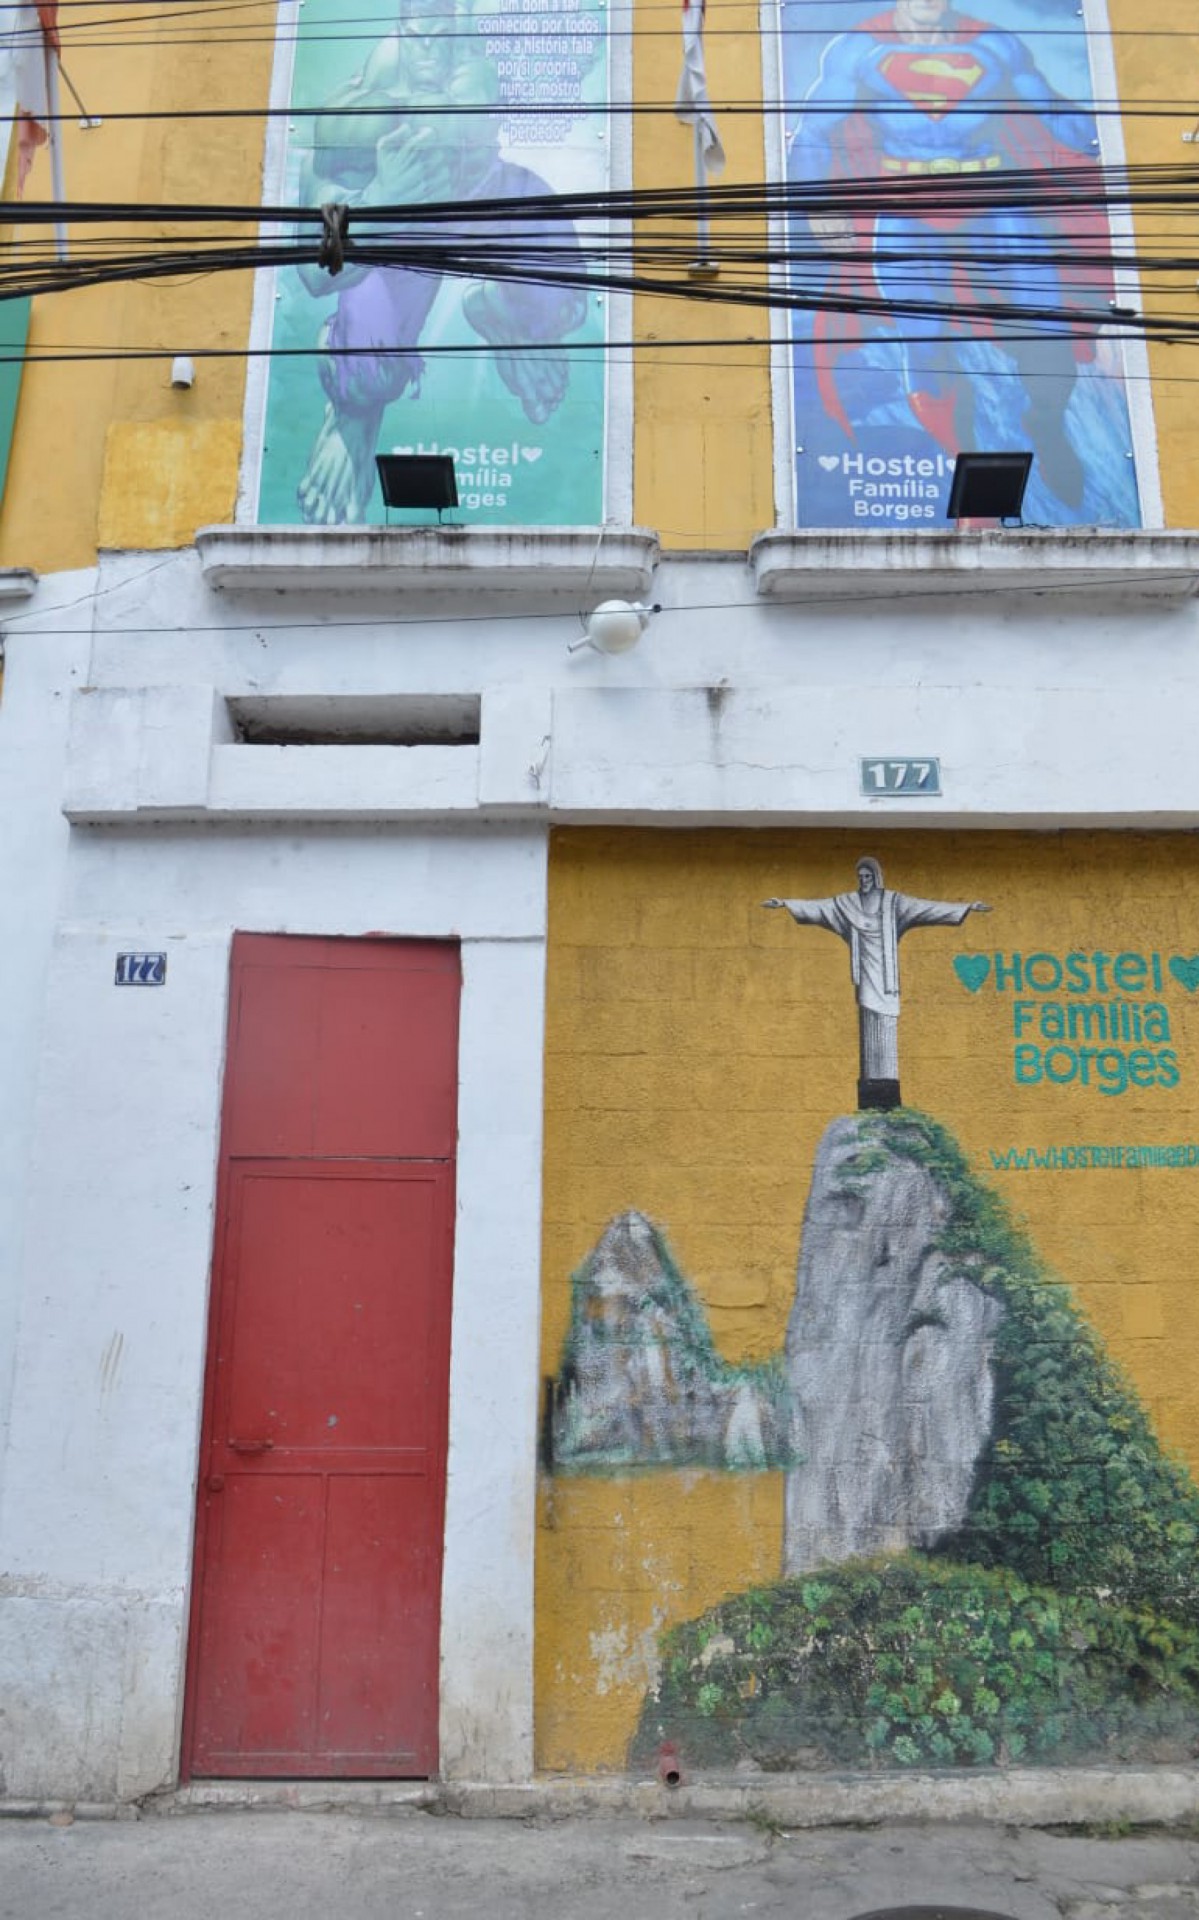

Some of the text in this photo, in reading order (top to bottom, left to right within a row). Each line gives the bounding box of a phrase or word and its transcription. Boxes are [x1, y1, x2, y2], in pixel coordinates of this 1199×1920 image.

[477, 17, 599, 34] conhecido por todos
[486, 39, 512, 55] pois
[523, 37, 569, 53] história
[572, 37, 594, 53] fala
[498, 61, 517, 78] por
[519, 59, 530, 75] si
[500, 80, 580, 96] nunca mostro
[842, 452, 944, 477] Hostel
[456, 467, 512, 487] mília
[849, 479, 940, 498] Família
[458, 492, 507, 510] rges
[854, 500, 935, 520] Borges
[868, 762, 930, 788] 177
[122, 956, 160, 981] 177
[995, 951, 1163, 994] Hostel
[1014, 1043, 1181, 1096] Borges
